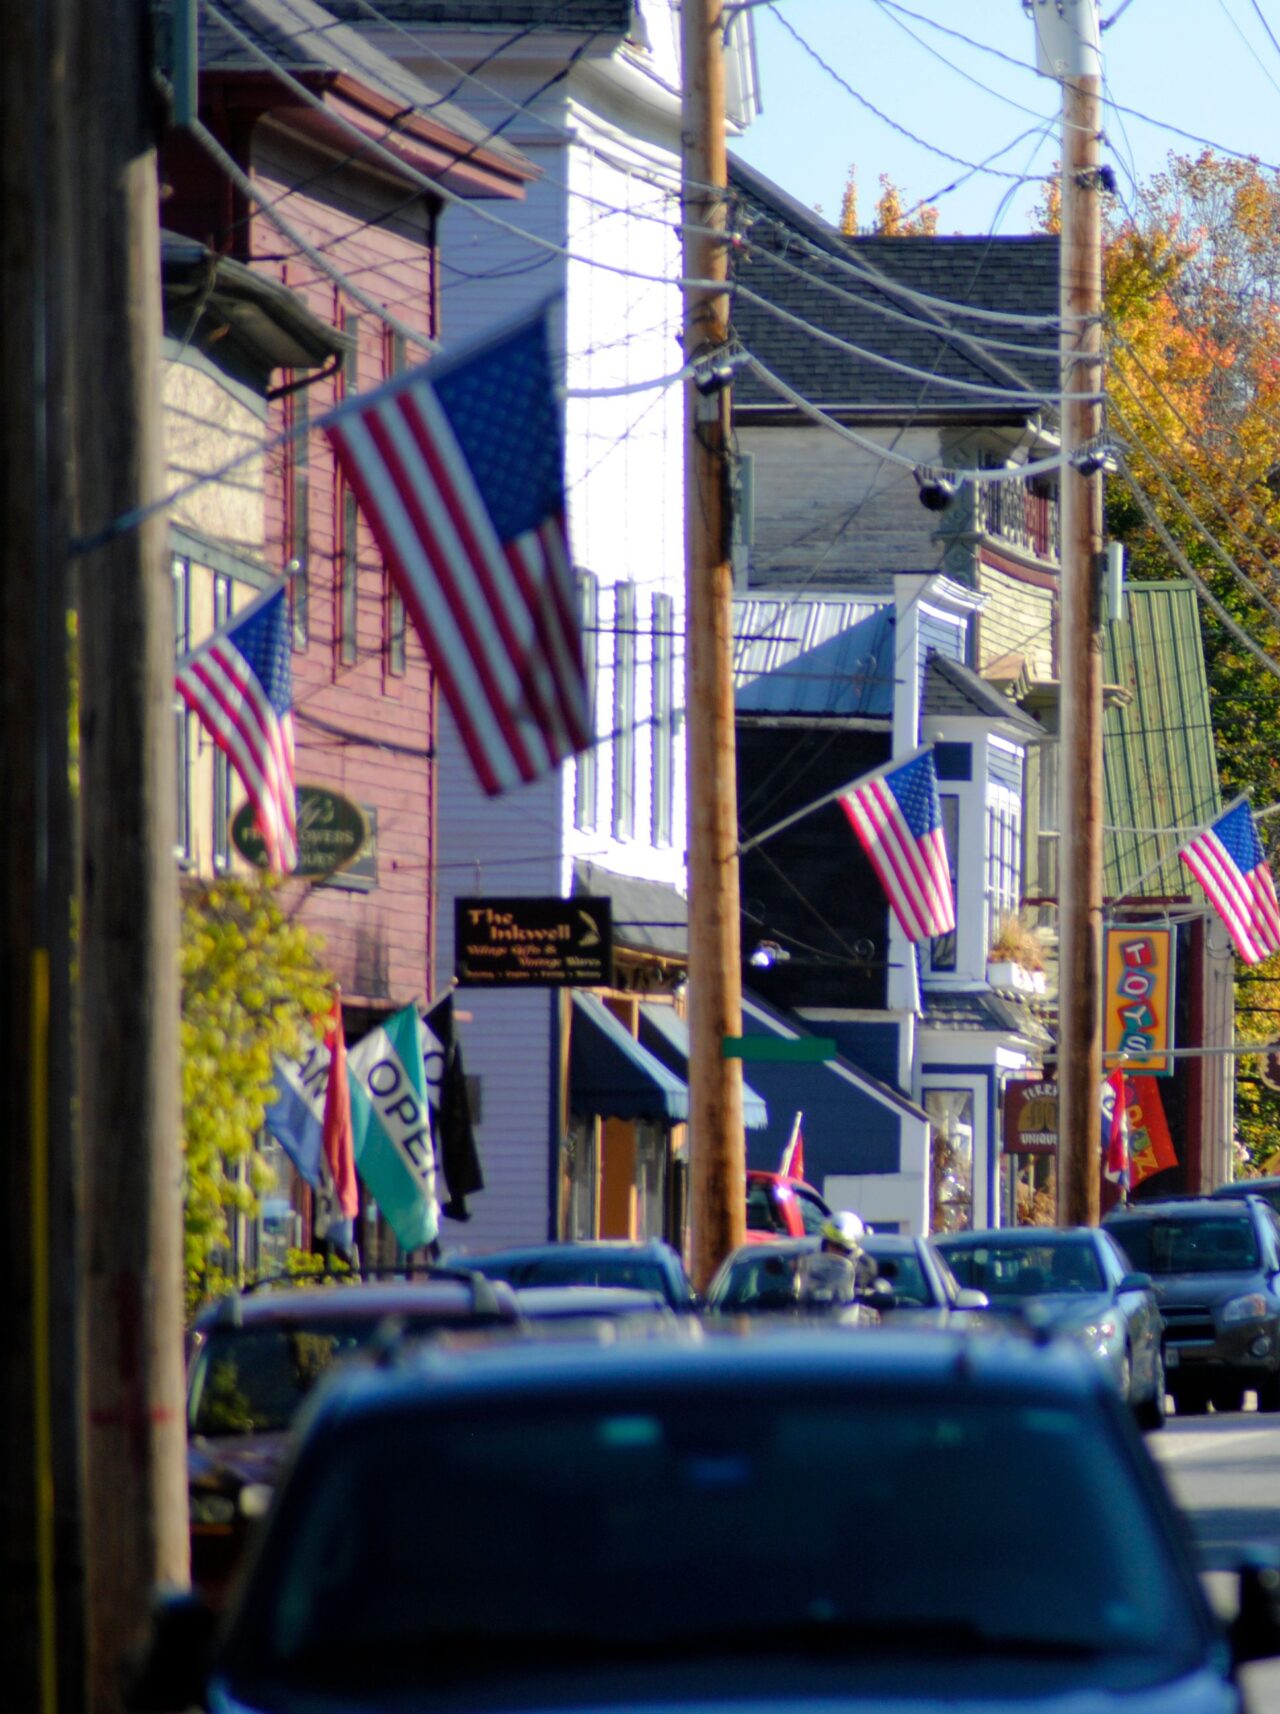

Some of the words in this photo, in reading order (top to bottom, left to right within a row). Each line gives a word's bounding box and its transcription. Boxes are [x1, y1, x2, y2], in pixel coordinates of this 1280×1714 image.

[467, 908, 513, 925] The
[490, 924, 571, 941] Inkwell
[1122, 942, 1149, 1053] TOYS
[368, 1060, 437, 1179] OPE
